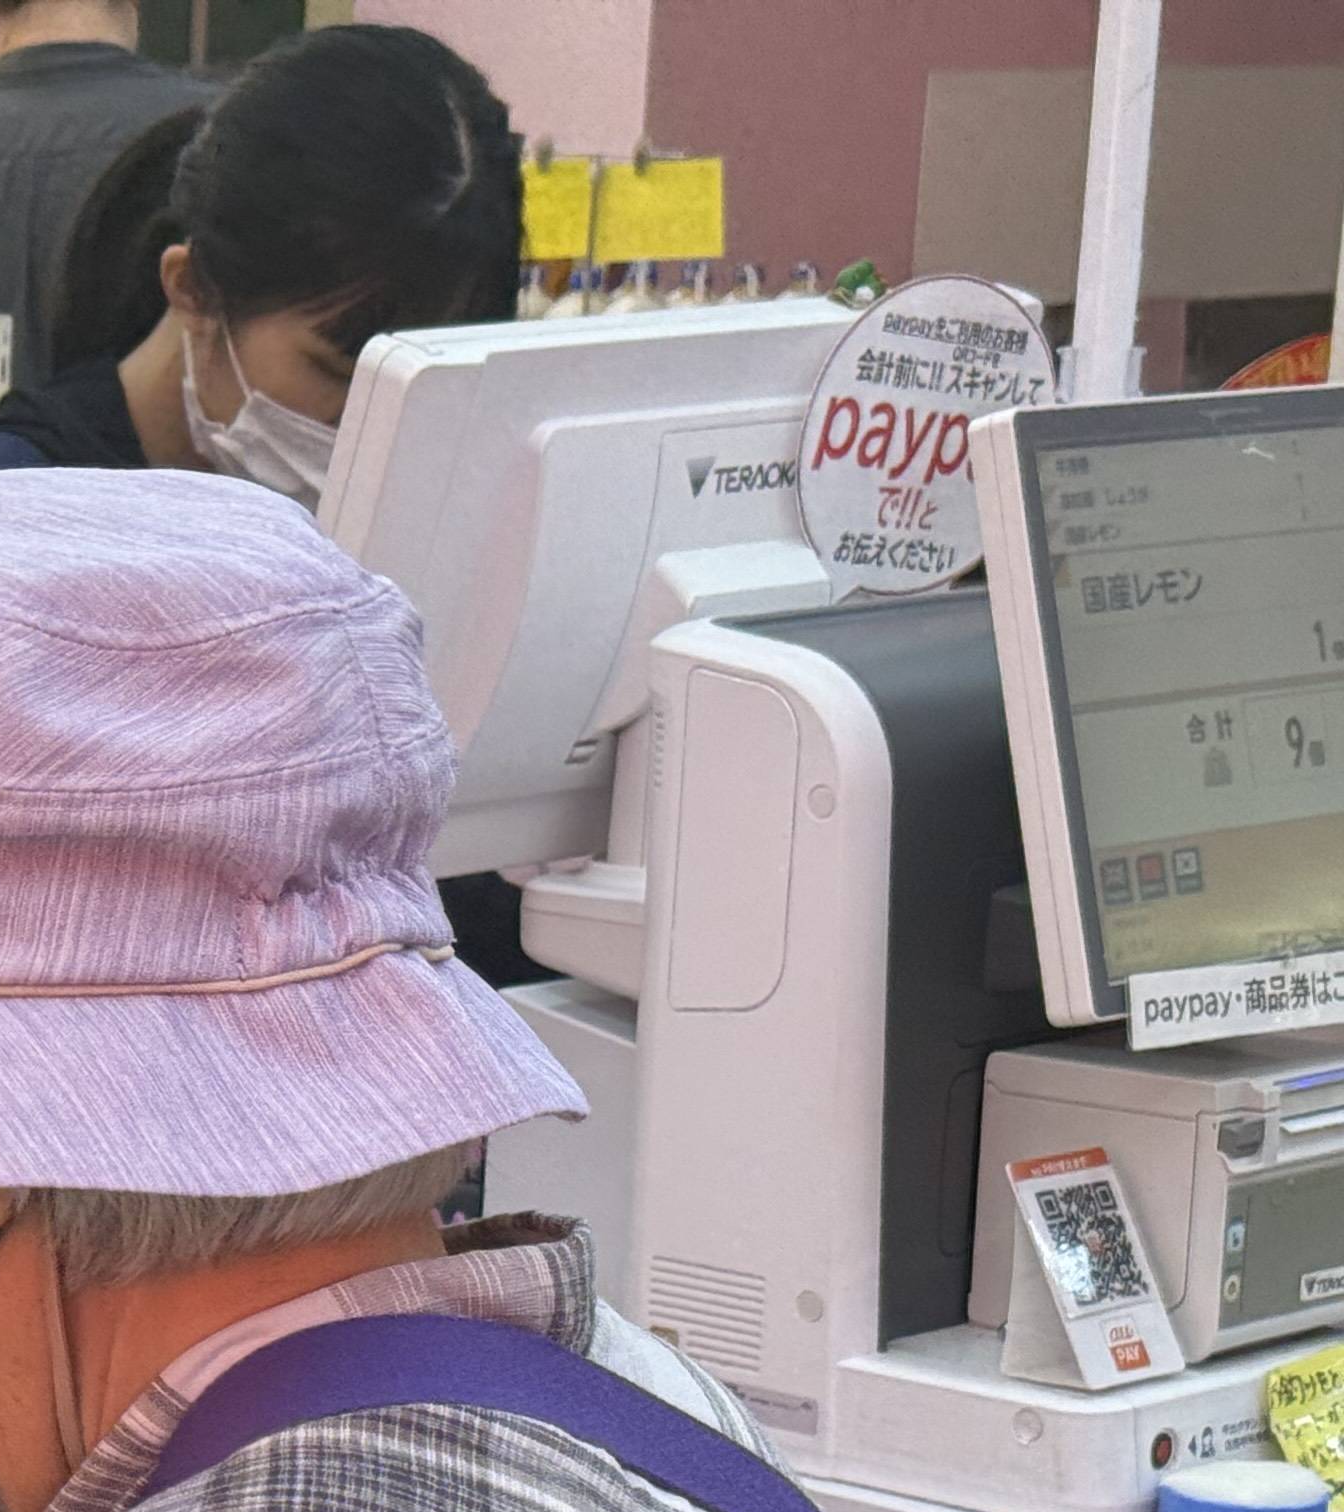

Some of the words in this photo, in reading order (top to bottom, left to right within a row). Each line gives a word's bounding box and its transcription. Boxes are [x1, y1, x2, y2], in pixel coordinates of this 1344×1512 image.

[856, 350, 945, 391] 会計前に!!
[946, 365, 1045, 406] スキャンして
[812, 395, 974, 484] payp
[878, 485, 939, 533] で!!と
[831, 531, 956, 574] お伝えください
[1081, 569, 1203, 615] 国産レモン
[1185, 710, 1233, 745] 合計
